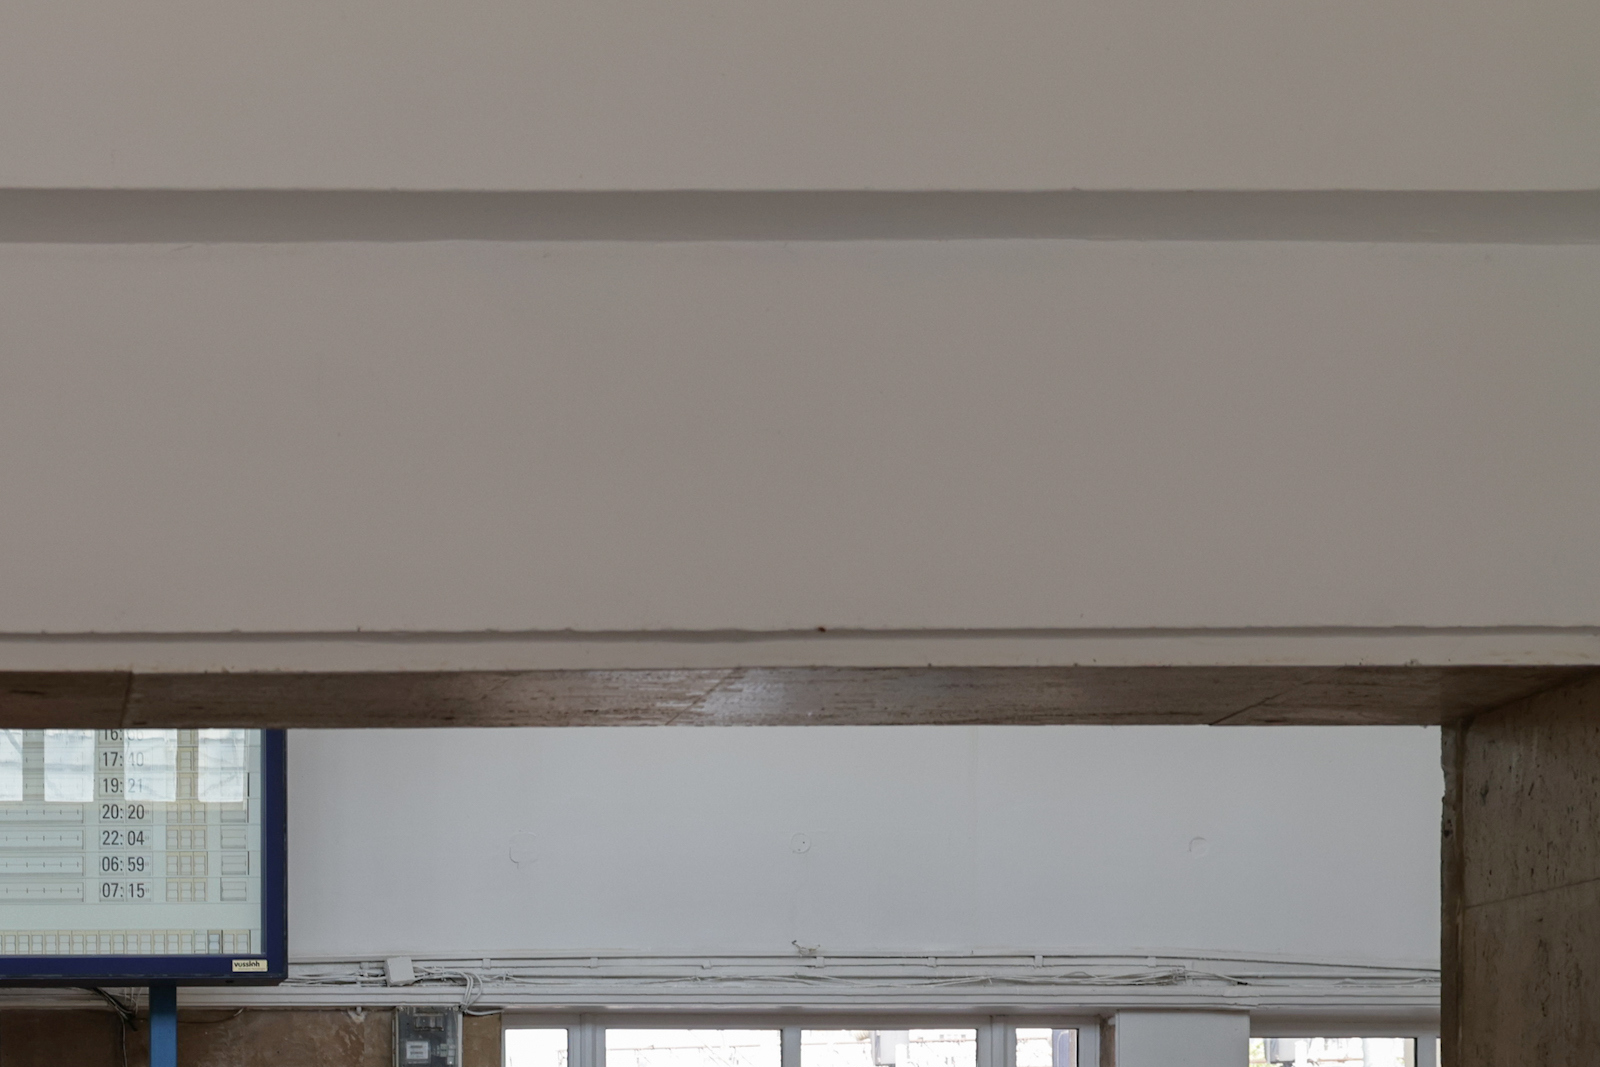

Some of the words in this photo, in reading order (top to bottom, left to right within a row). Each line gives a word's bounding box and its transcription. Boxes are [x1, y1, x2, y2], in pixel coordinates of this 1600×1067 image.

[102, 752, 144, 767] 17:40
[103, 778, 143, 793] 19:21
[102, 804, 145, 820] 20:20
[102, 830, 145, 846] 22:04
[101, 856, 145, 872] 06:59
[102, 883, 145, 898] 07:15
